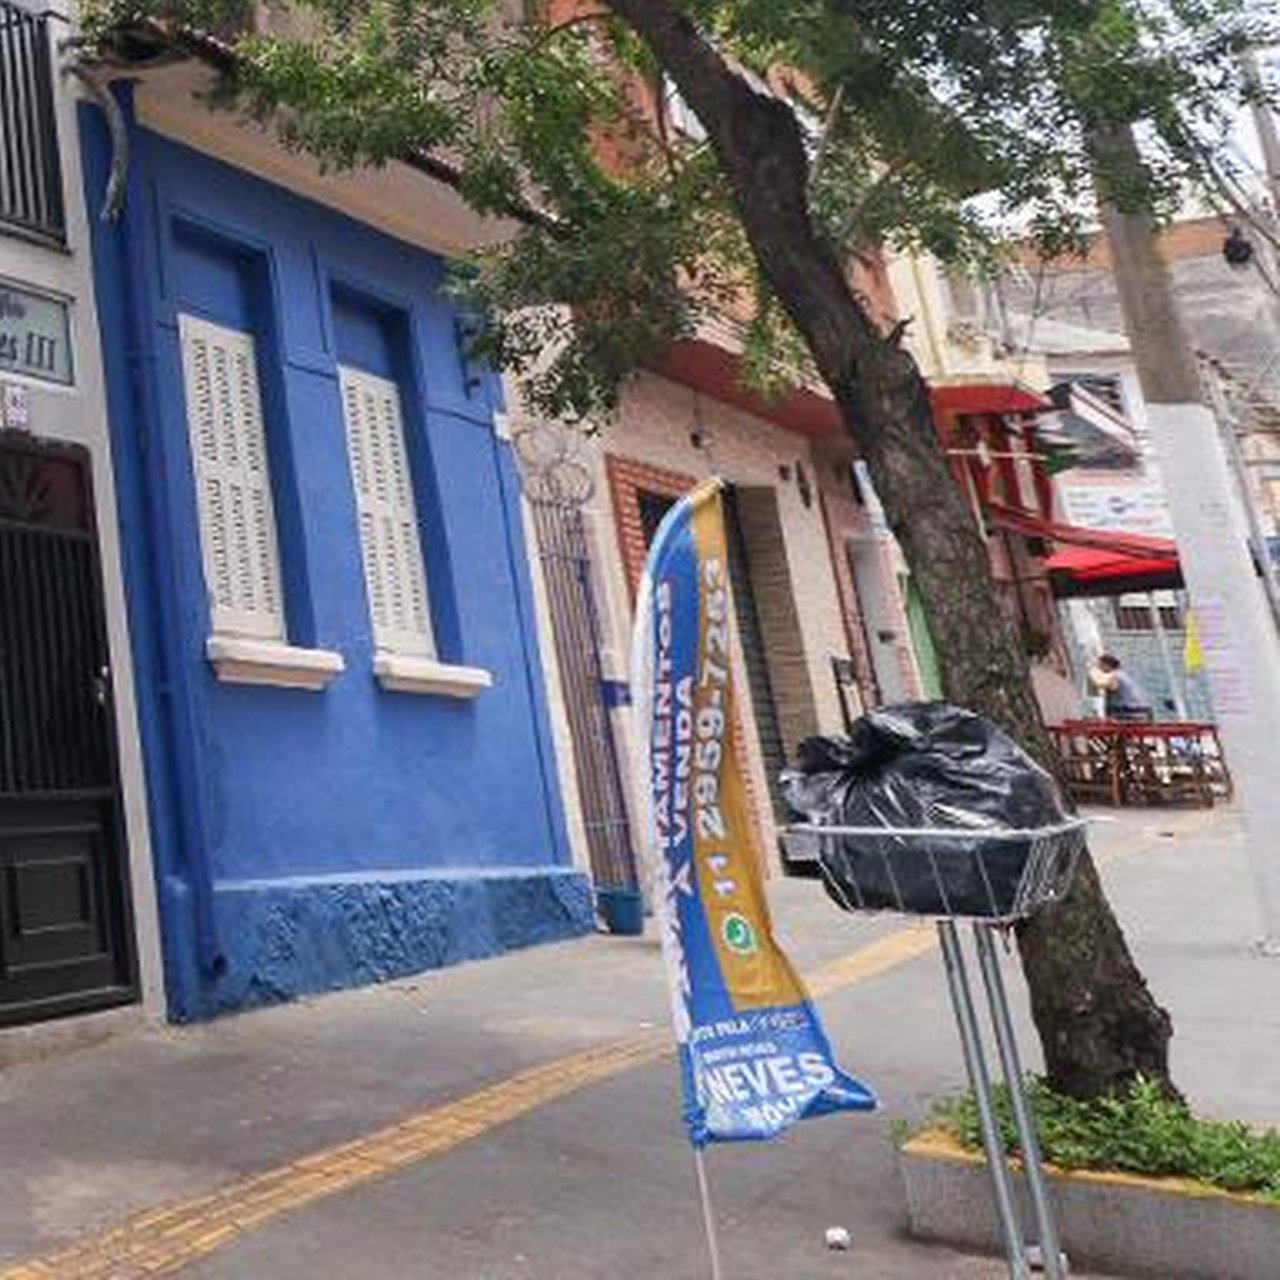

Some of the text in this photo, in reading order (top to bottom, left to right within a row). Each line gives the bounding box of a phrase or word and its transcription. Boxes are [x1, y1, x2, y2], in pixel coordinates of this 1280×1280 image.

[25, 332, 55, 371] III
[672, 675, 693, 847] VENDA
[704, 1053, 835, 1106] NEVES
